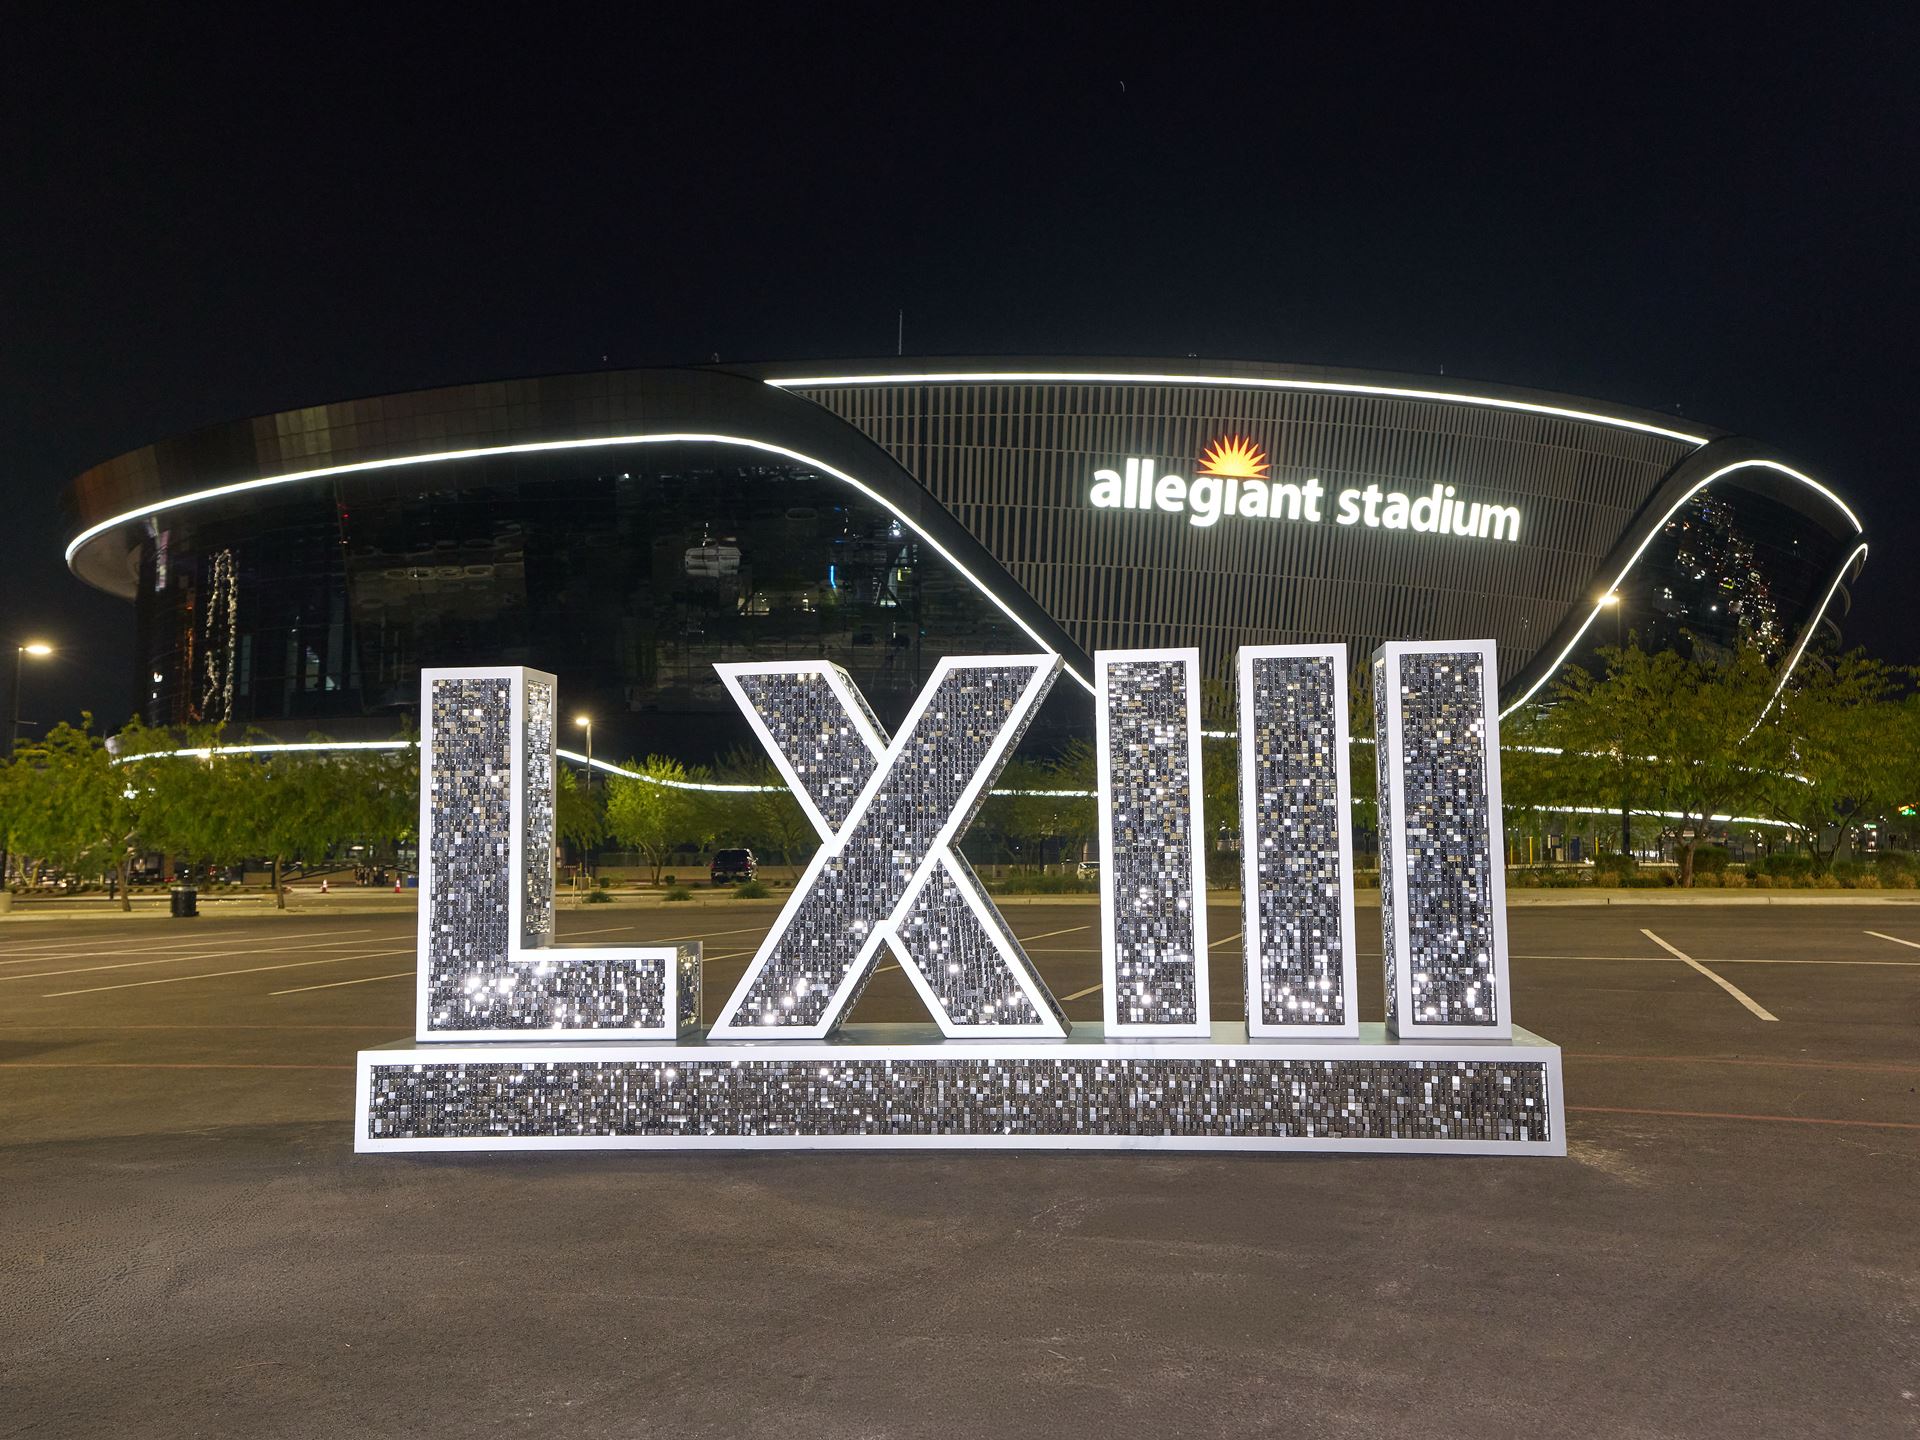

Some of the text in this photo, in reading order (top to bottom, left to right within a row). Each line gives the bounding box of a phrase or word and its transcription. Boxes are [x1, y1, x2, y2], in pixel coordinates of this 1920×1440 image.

[1089, 457, 1521, 542] allegiant stadium
[416, 639, 1512, 1042] LXIII
